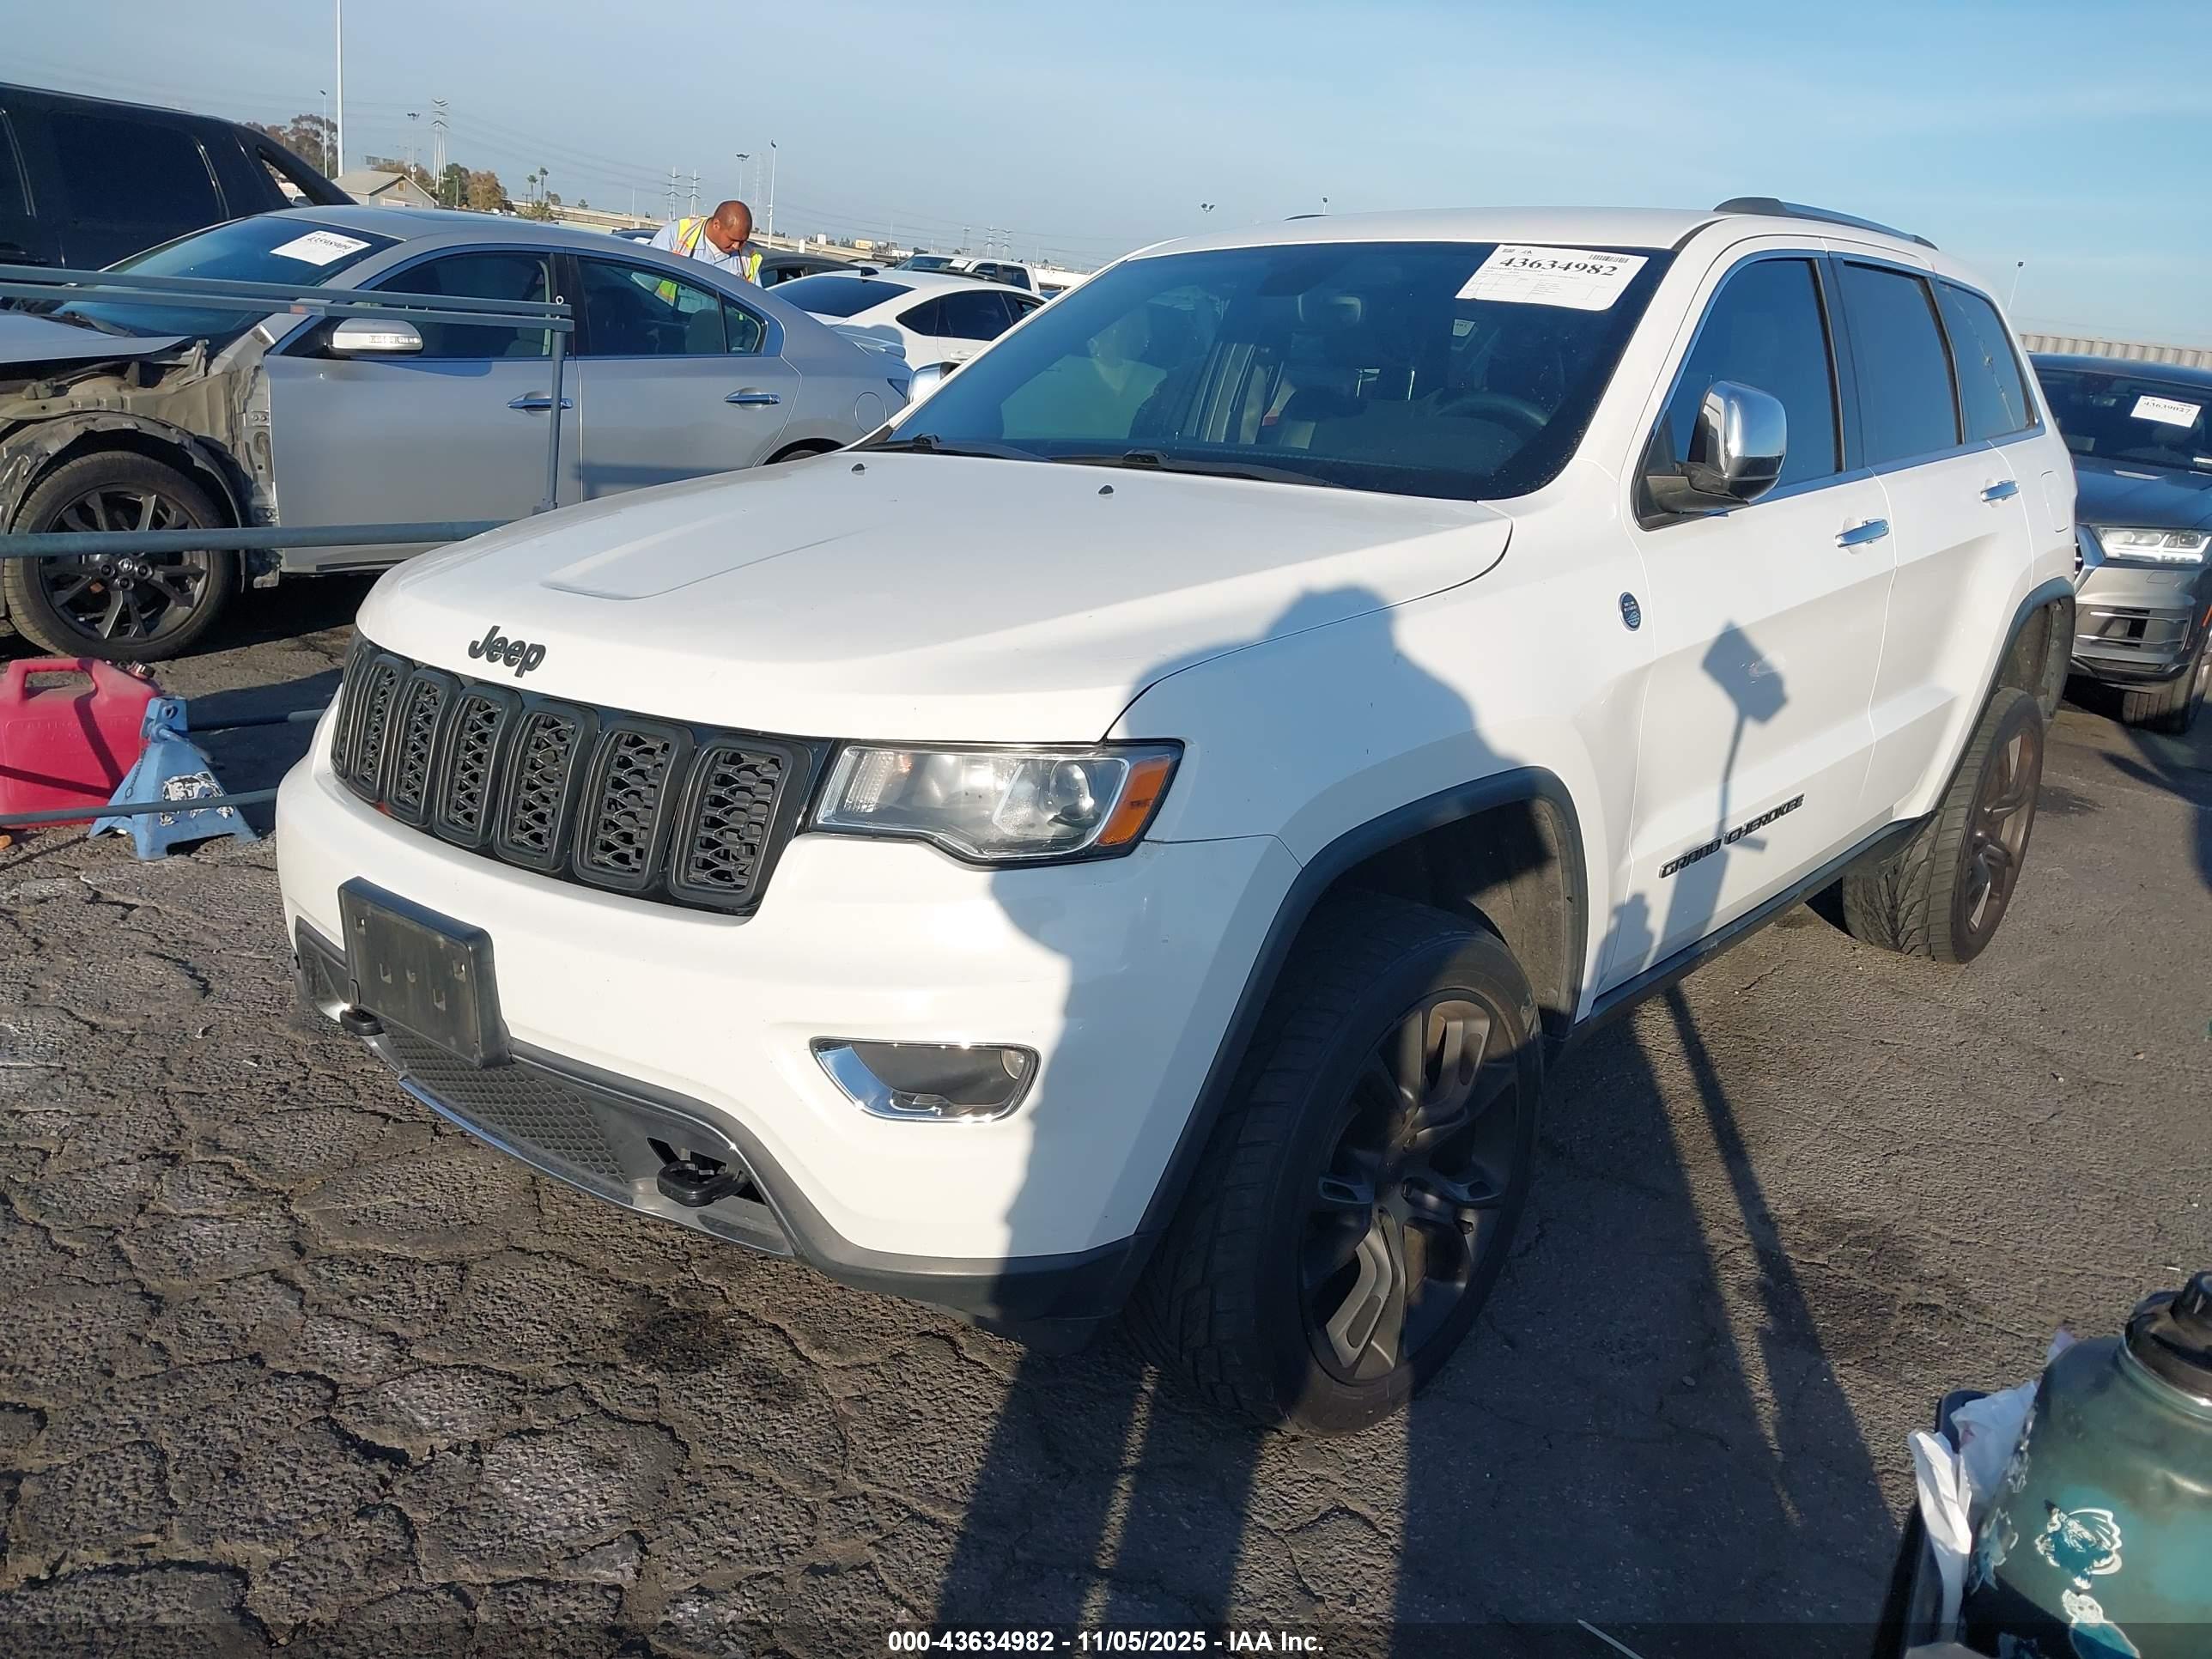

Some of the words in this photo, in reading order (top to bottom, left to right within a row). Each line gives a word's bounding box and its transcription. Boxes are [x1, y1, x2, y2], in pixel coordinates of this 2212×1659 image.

[1498, 257, 1619, 276] 43634982
[468, 624, 547, 678] Jeep
[1658, 836, 1723, 879] GRAND
[1723, 792, 1806, 846] CHEROKEE
